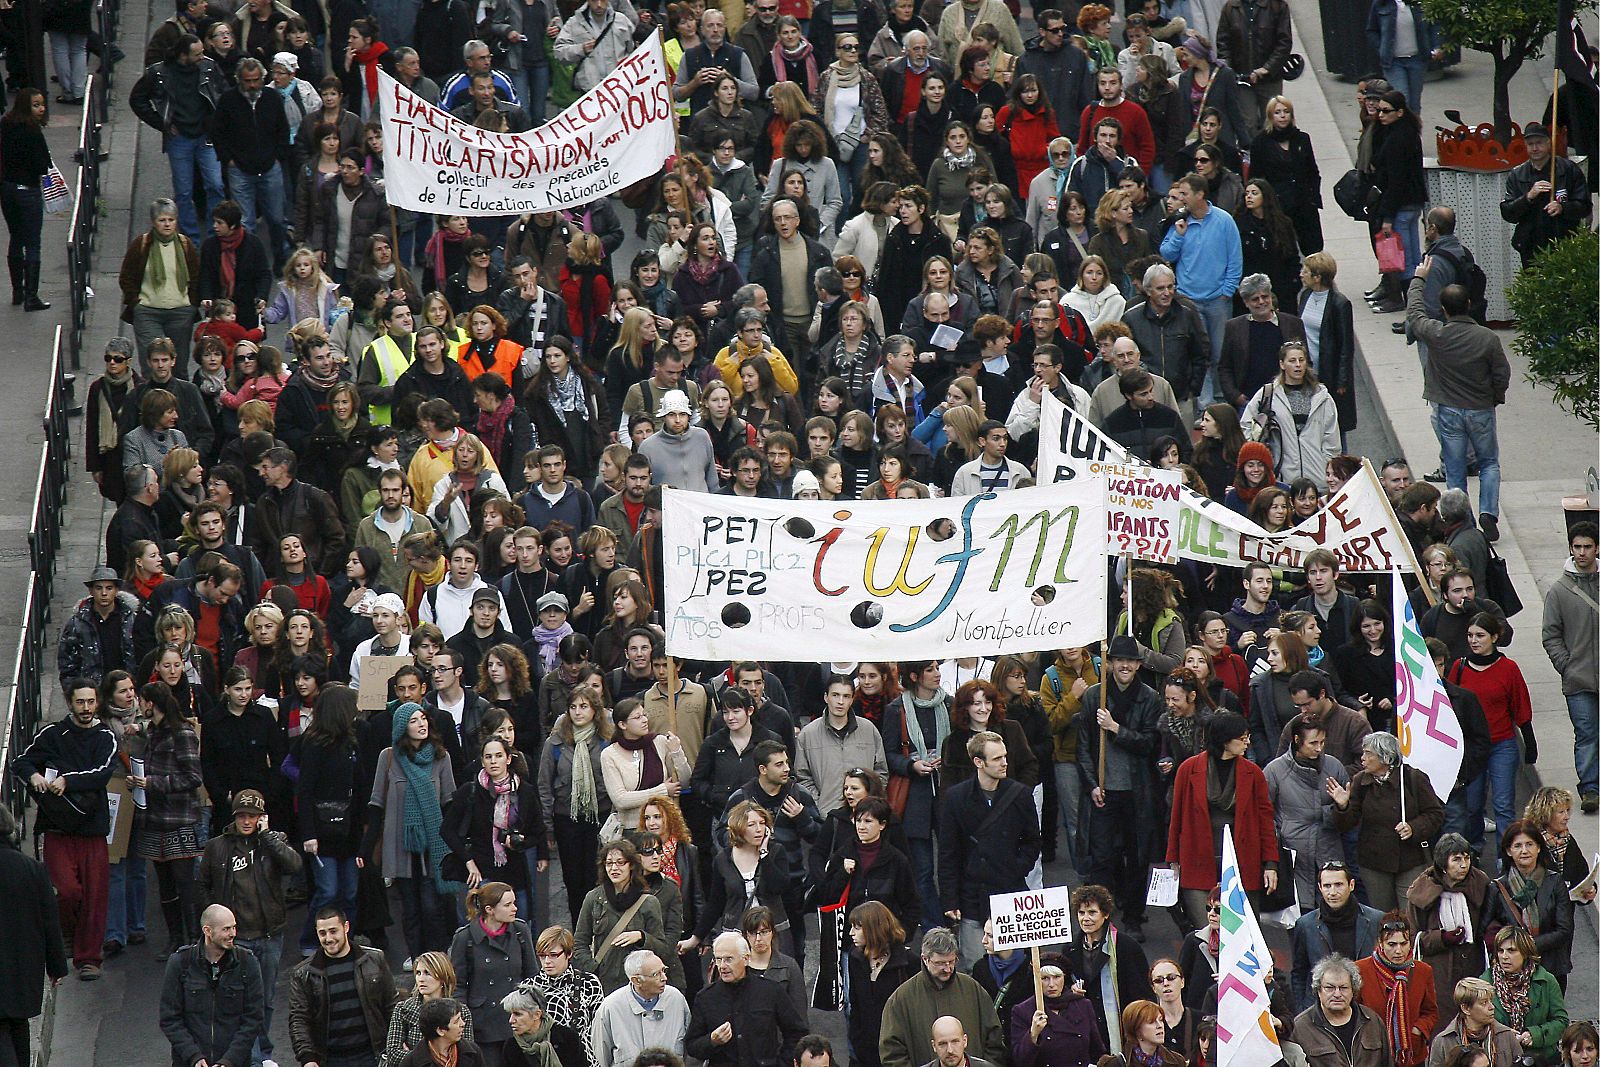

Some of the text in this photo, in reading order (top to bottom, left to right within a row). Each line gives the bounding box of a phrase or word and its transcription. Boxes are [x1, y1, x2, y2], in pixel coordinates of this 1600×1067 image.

[418, 186, 436, 203] de
[545, 170, 620, 206] Nationale
[437, 169, 492, 188] Collectif
[512, 179, 536, 190] des
[1089, 463, 1136, 478] QUELLE
[1131, 498, 1154, 510] NOS
[677, 544, 807, 570] PLC1 PLC2
[706, 569, 767, 596] PE2
[759, 602, 825, 633] PROFS
[945, 606, 1072, 648] Montpellier
[1014, 893, 1045, 912] NON
[996, 908, 1065, 925] AU SACCAGE
[1000, 918, 1062, 934] DE L'ECOLE
[998, 927, 1068, 945] MATERNELLE
